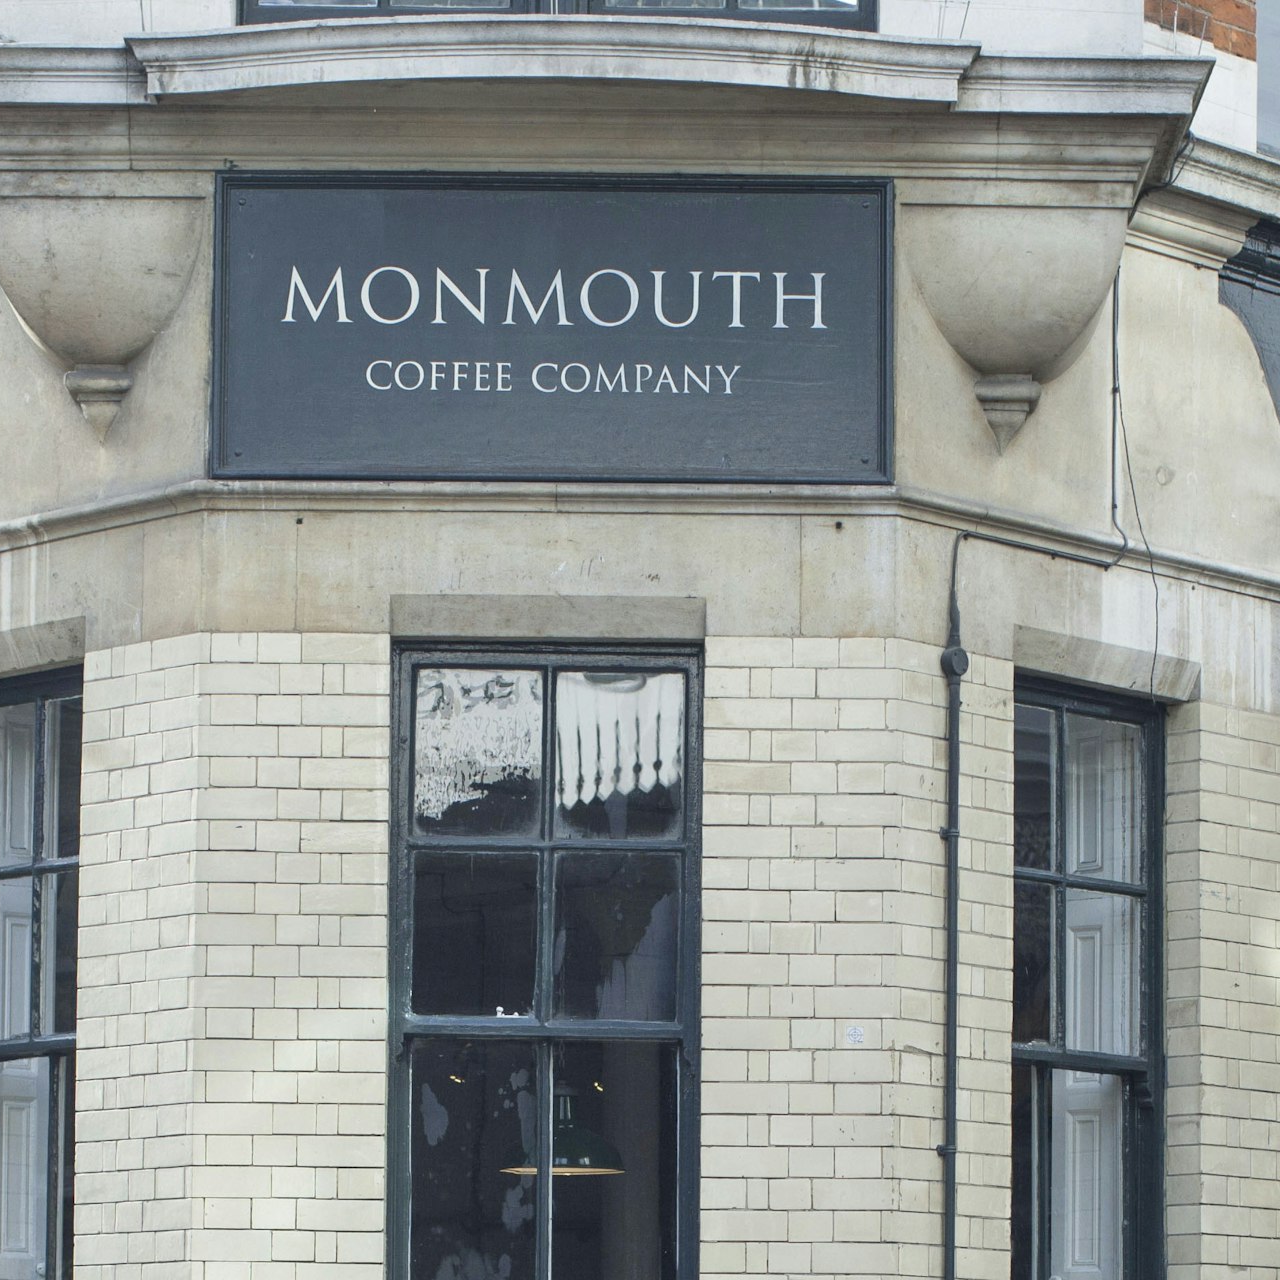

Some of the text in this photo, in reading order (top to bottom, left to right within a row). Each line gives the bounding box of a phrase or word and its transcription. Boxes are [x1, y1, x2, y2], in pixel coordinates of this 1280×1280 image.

[281, 265, 828, 330] MONMOUTH
[365, 360, 741, 395] COFFEE COMPANY
